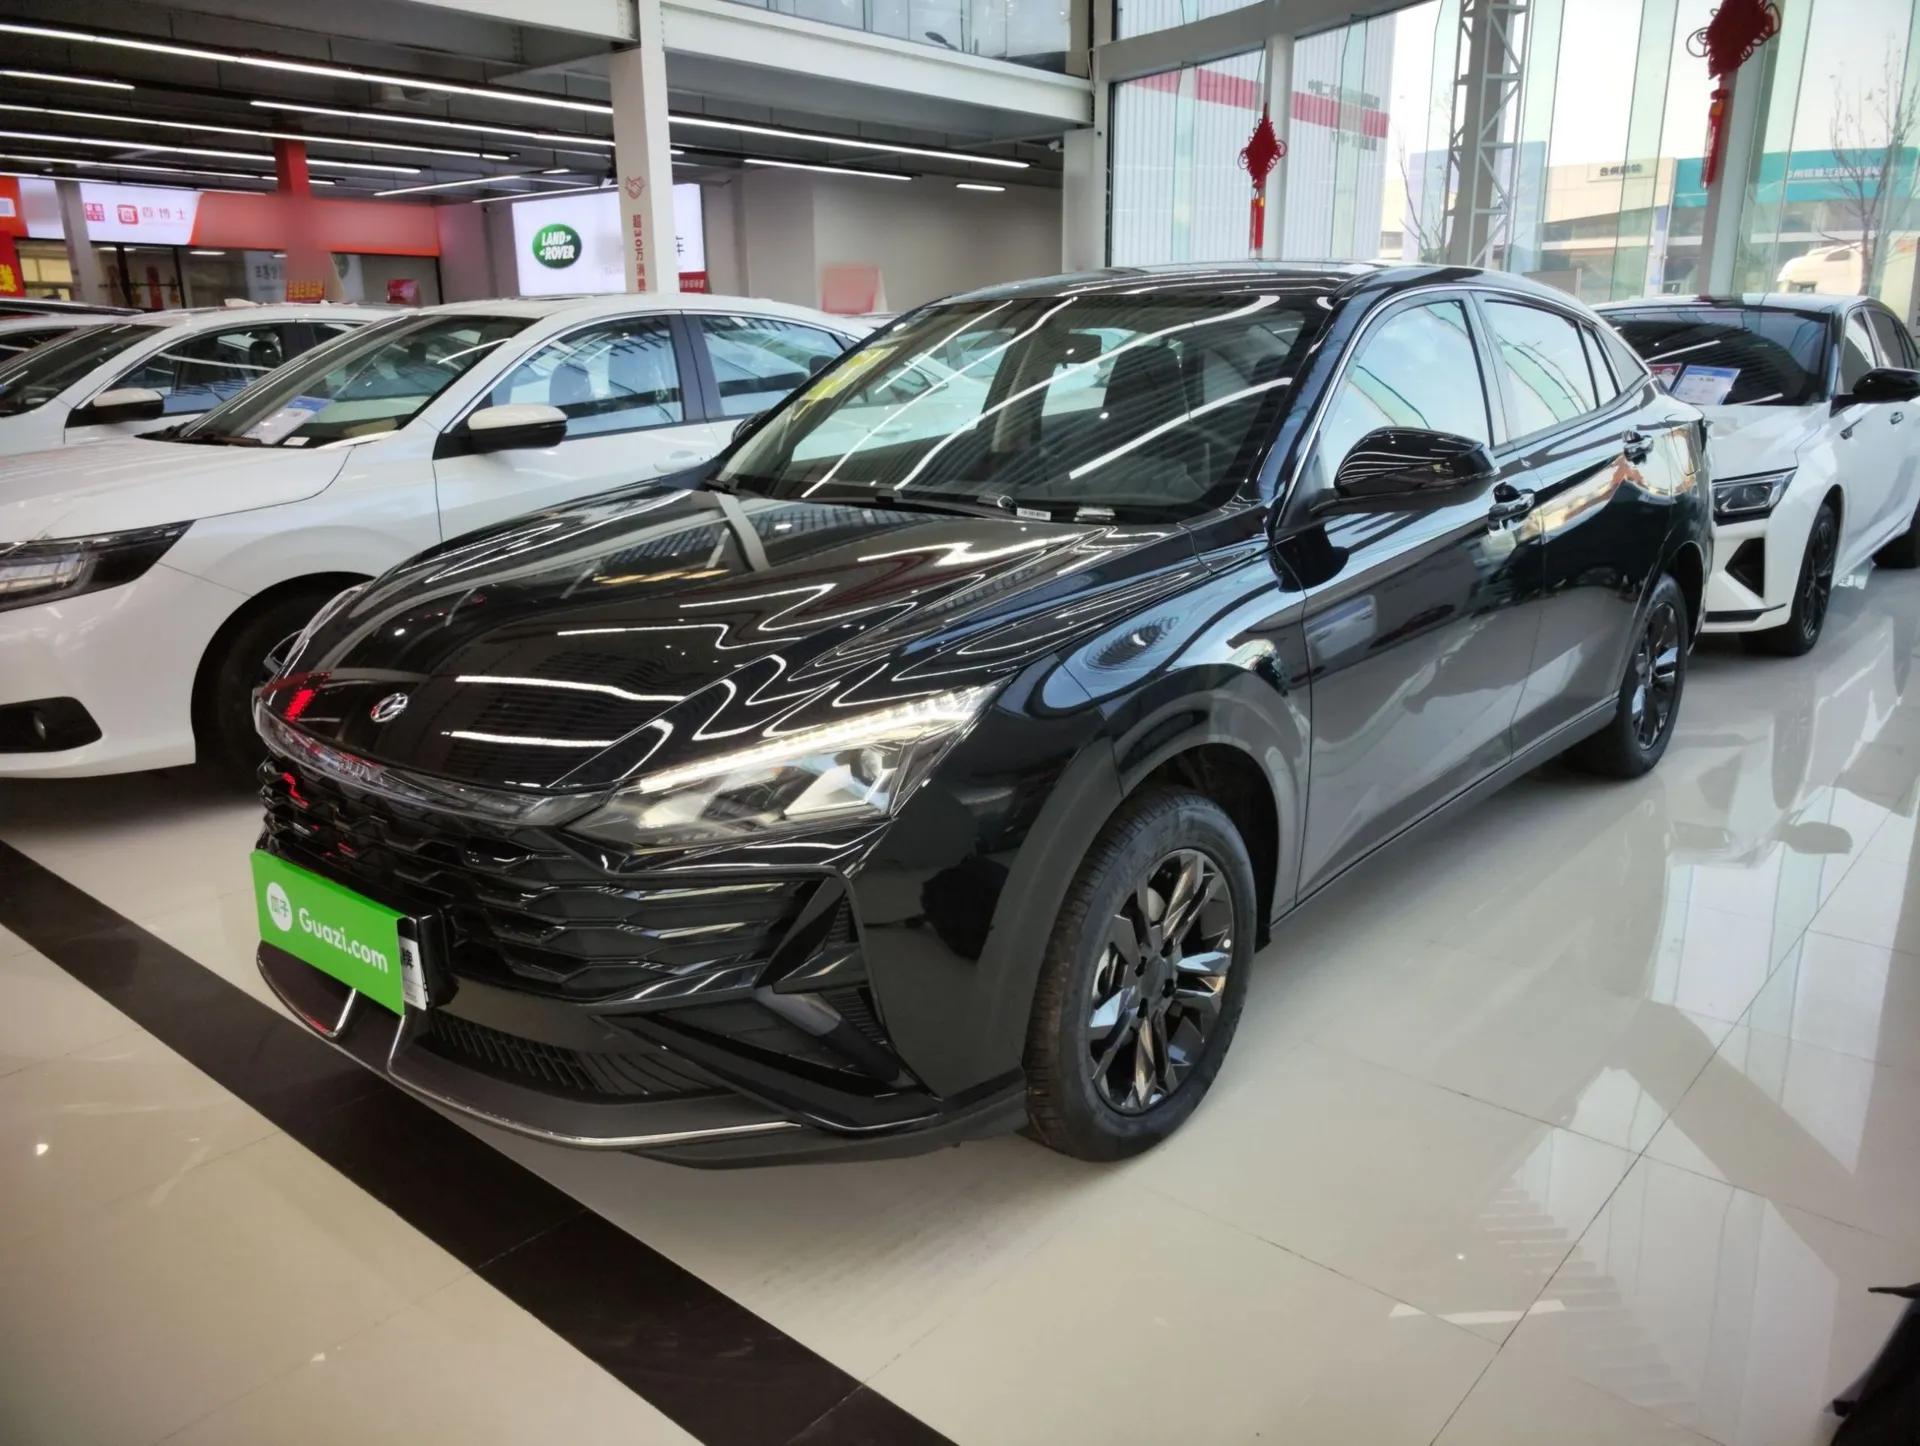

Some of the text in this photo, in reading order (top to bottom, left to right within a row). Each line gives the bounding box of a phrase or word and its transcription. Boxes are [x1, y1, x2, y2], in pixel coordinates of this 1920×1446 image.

[541, 230, 566, 247] LAND
[544, 245, 575, 261] ROVER
[299, 907, 389, 974] Guazi.com
